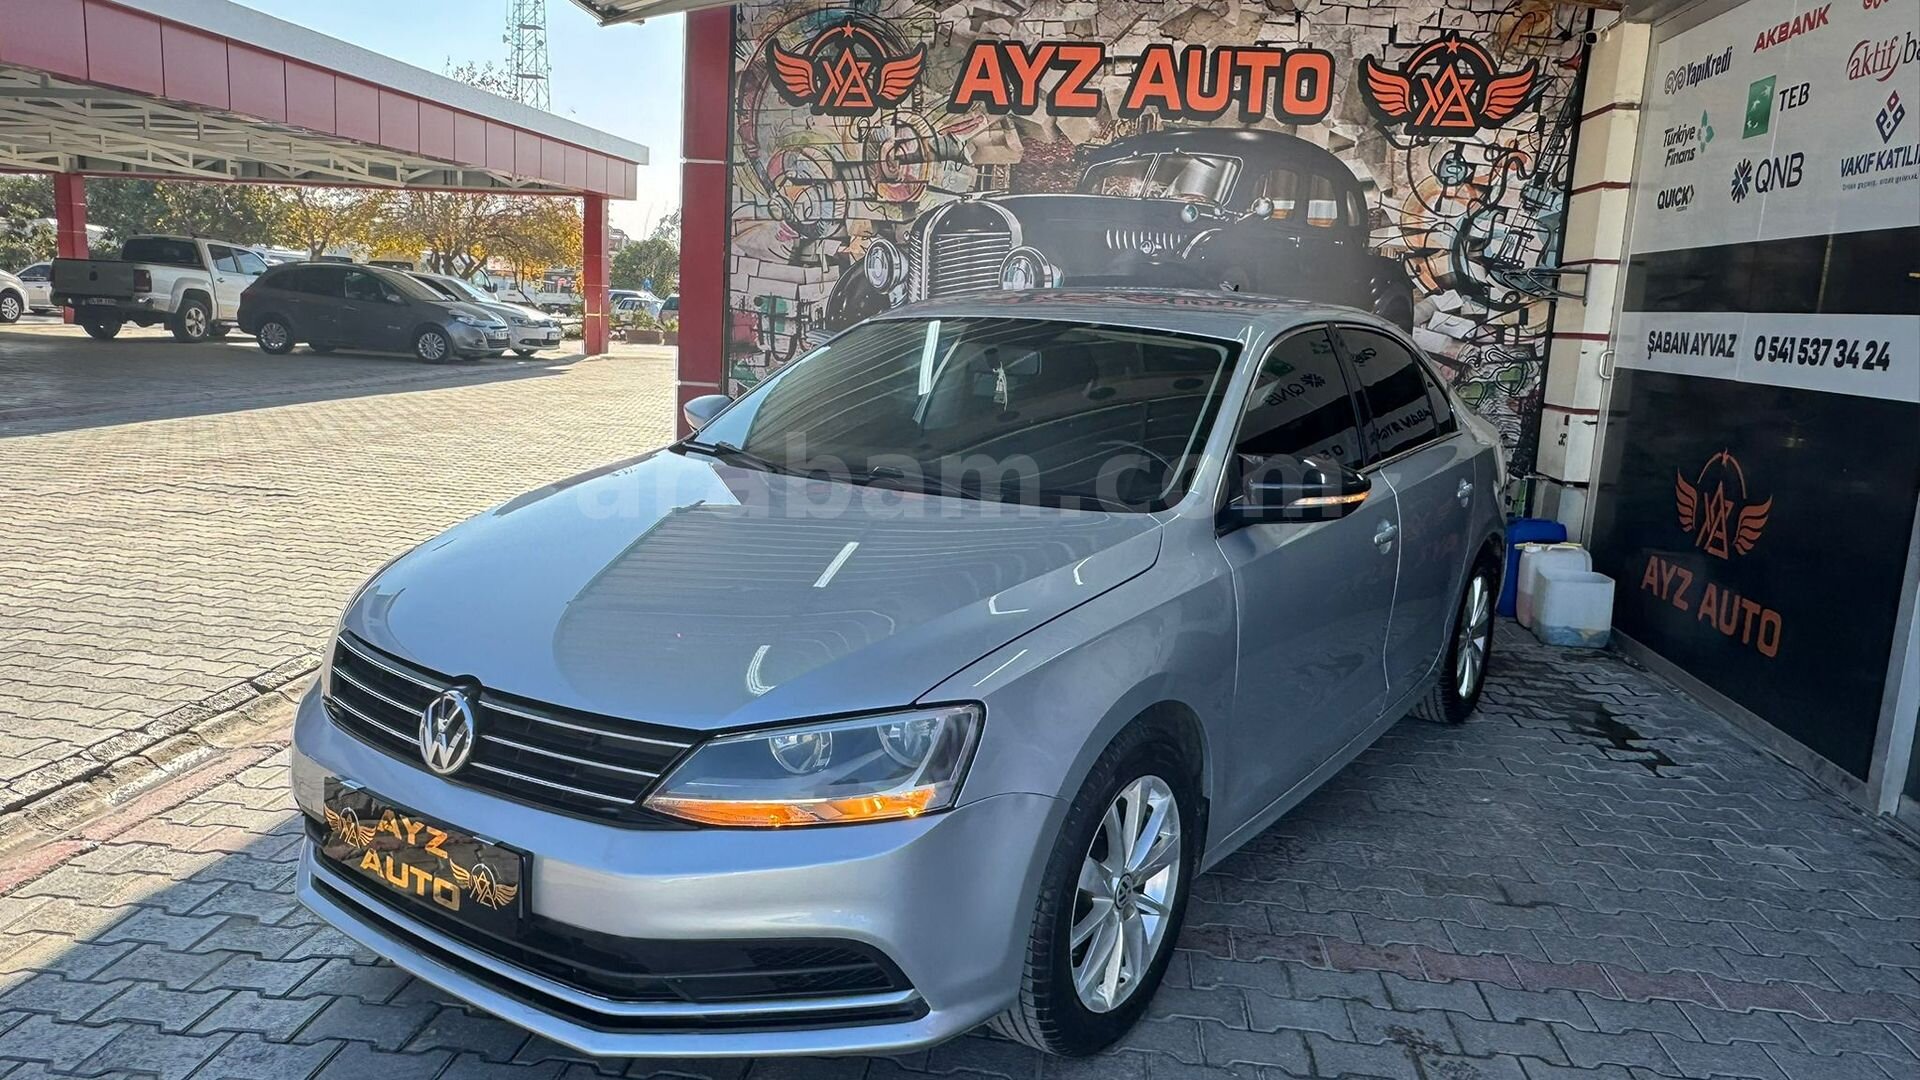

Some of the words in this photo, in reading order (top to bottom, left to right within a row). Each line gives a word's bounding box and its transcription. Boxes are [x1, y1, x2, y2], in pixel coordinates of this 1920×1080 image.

[1753, 2, 1832, 53] AKBANK
[954, 44, 1100, 106] AYZ
[1127, 48, 1331, 115] AUTO
[1849, 35, 1899, 81] aktif
[1779, 82, 1811, 112] TEB
[1664, 147, 1696, 168] Finans
[1755, 151, 1805, 193] QNB
[1841, 152, 1876, 178] VAKIF
[1875, 143, 1919, 172] KATILI
[1648, 331, 1690, 359] ŞABAN
[1690, 333, 1737, 358] AYVAZ
[1754, 335, 1766, 361] 0
[1768, 337, 1796, 363] 541
[1798, 338, 1833, 366] 537
[1834, 339, 1860, 369] 34
[1862, 340, 1890, 371] 24
[1641, 555, 1693, 611] AYZ
[1698, 583, 1782, 657] AUTO
[377, 809, 448, 859] AYZ
[360, 849, 460, 911] AUTO
